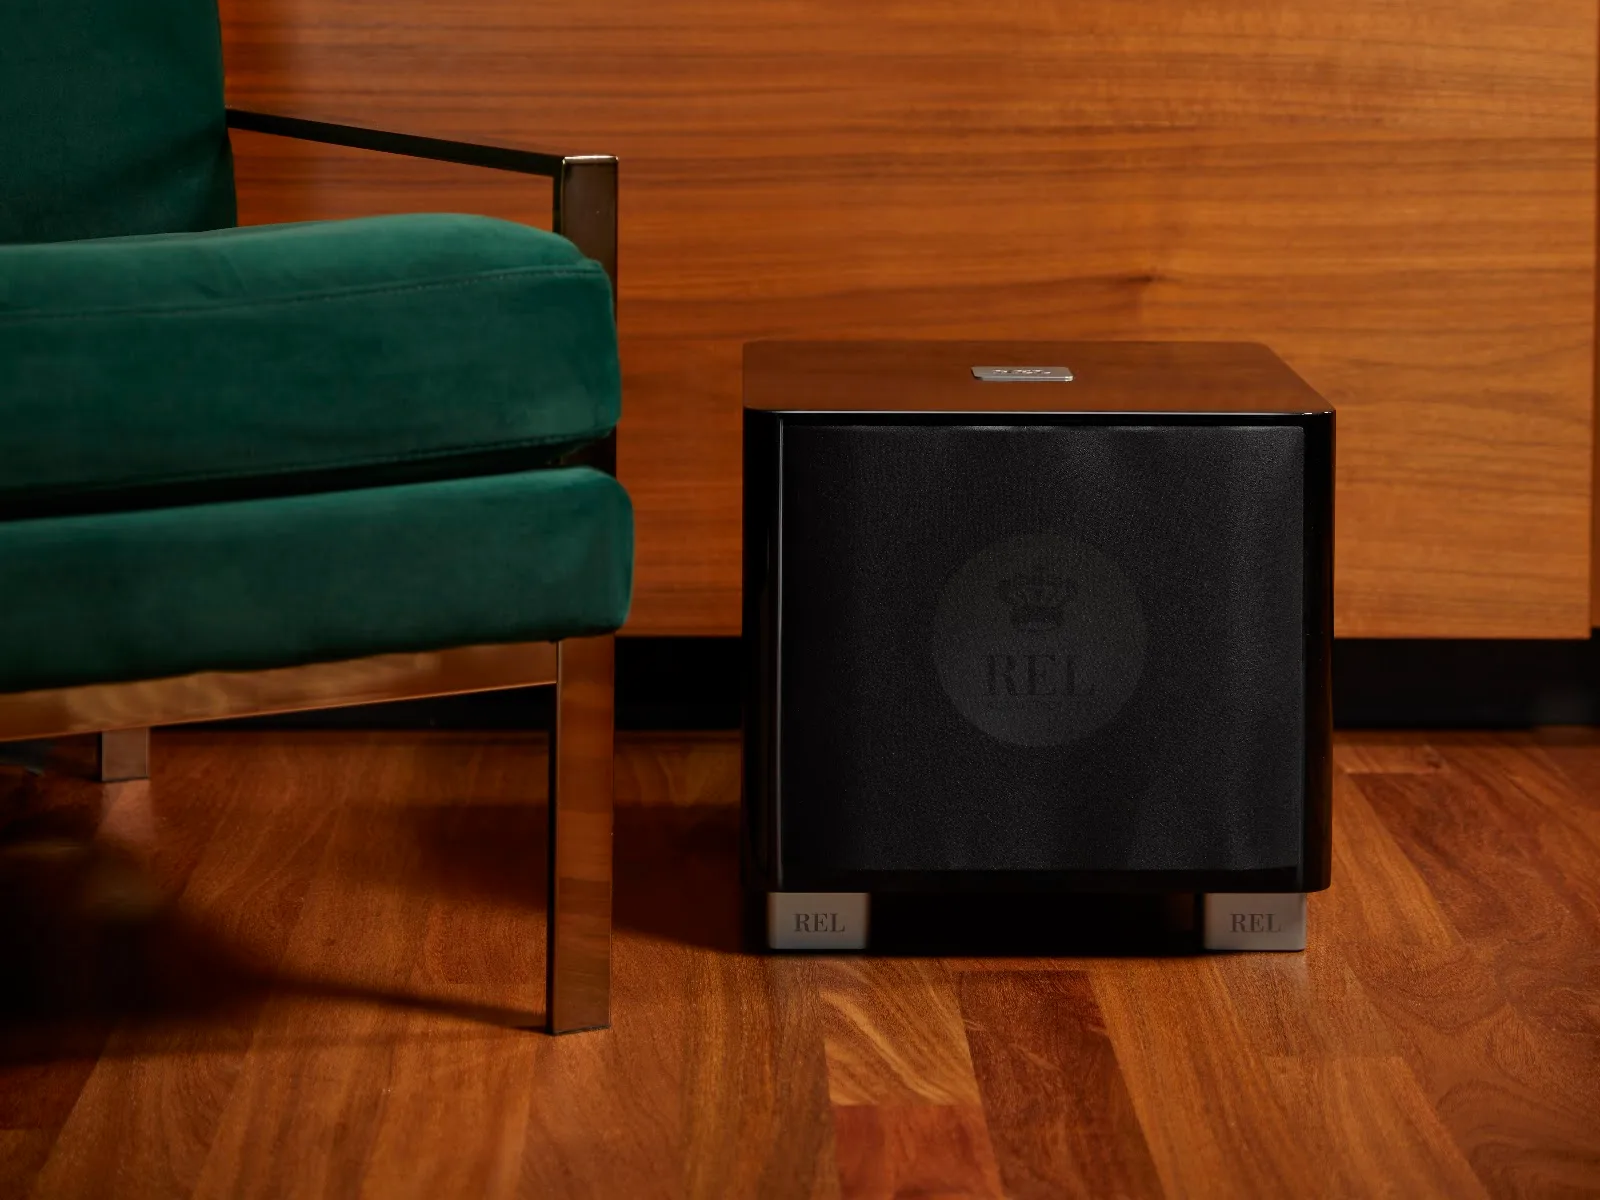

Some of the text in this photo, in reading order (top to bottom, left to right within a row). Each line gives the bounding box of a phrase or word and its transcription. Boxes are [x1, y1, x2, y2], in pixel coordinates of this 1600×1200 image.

[982, 654, 1098, 697] REL
[794, 912, 846, 934] REL
[1229, 912, 1282, 934] REL
